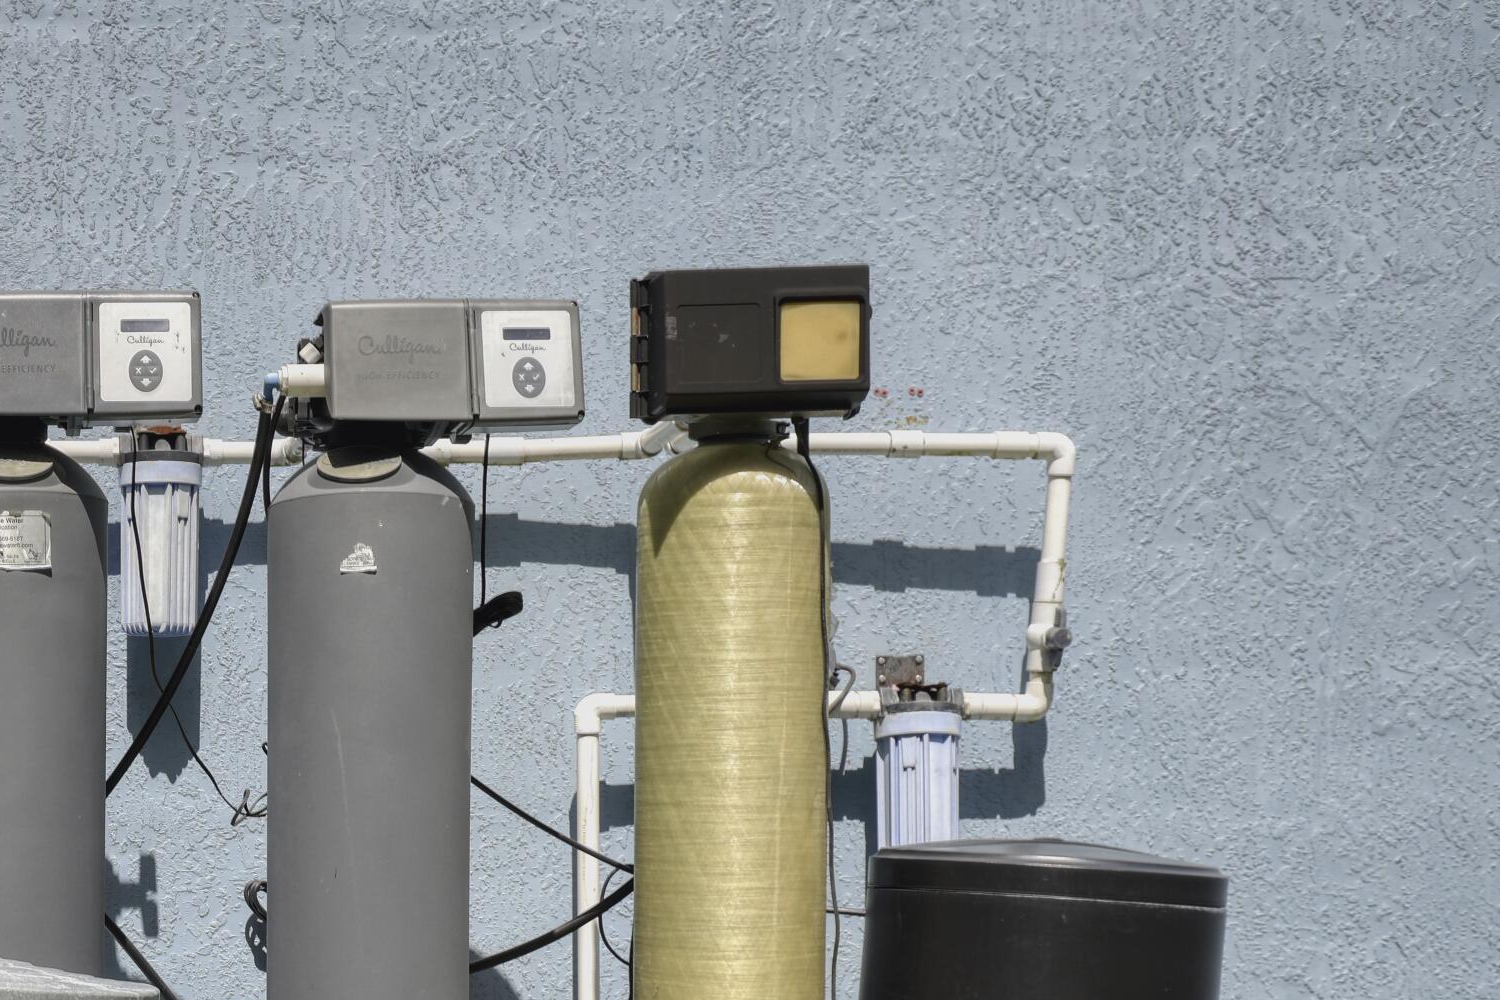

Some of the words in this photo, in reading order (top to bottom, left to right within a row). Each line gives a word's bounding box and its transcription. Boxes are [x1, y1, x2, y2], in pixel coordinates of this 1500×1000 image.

[126, 335, 165, 347] Culligan
[358, 334, 443, 365] Culligan
[509, 342, 547, 354] Culligan
[1, 364, 56, 374] EFFICIENCY
